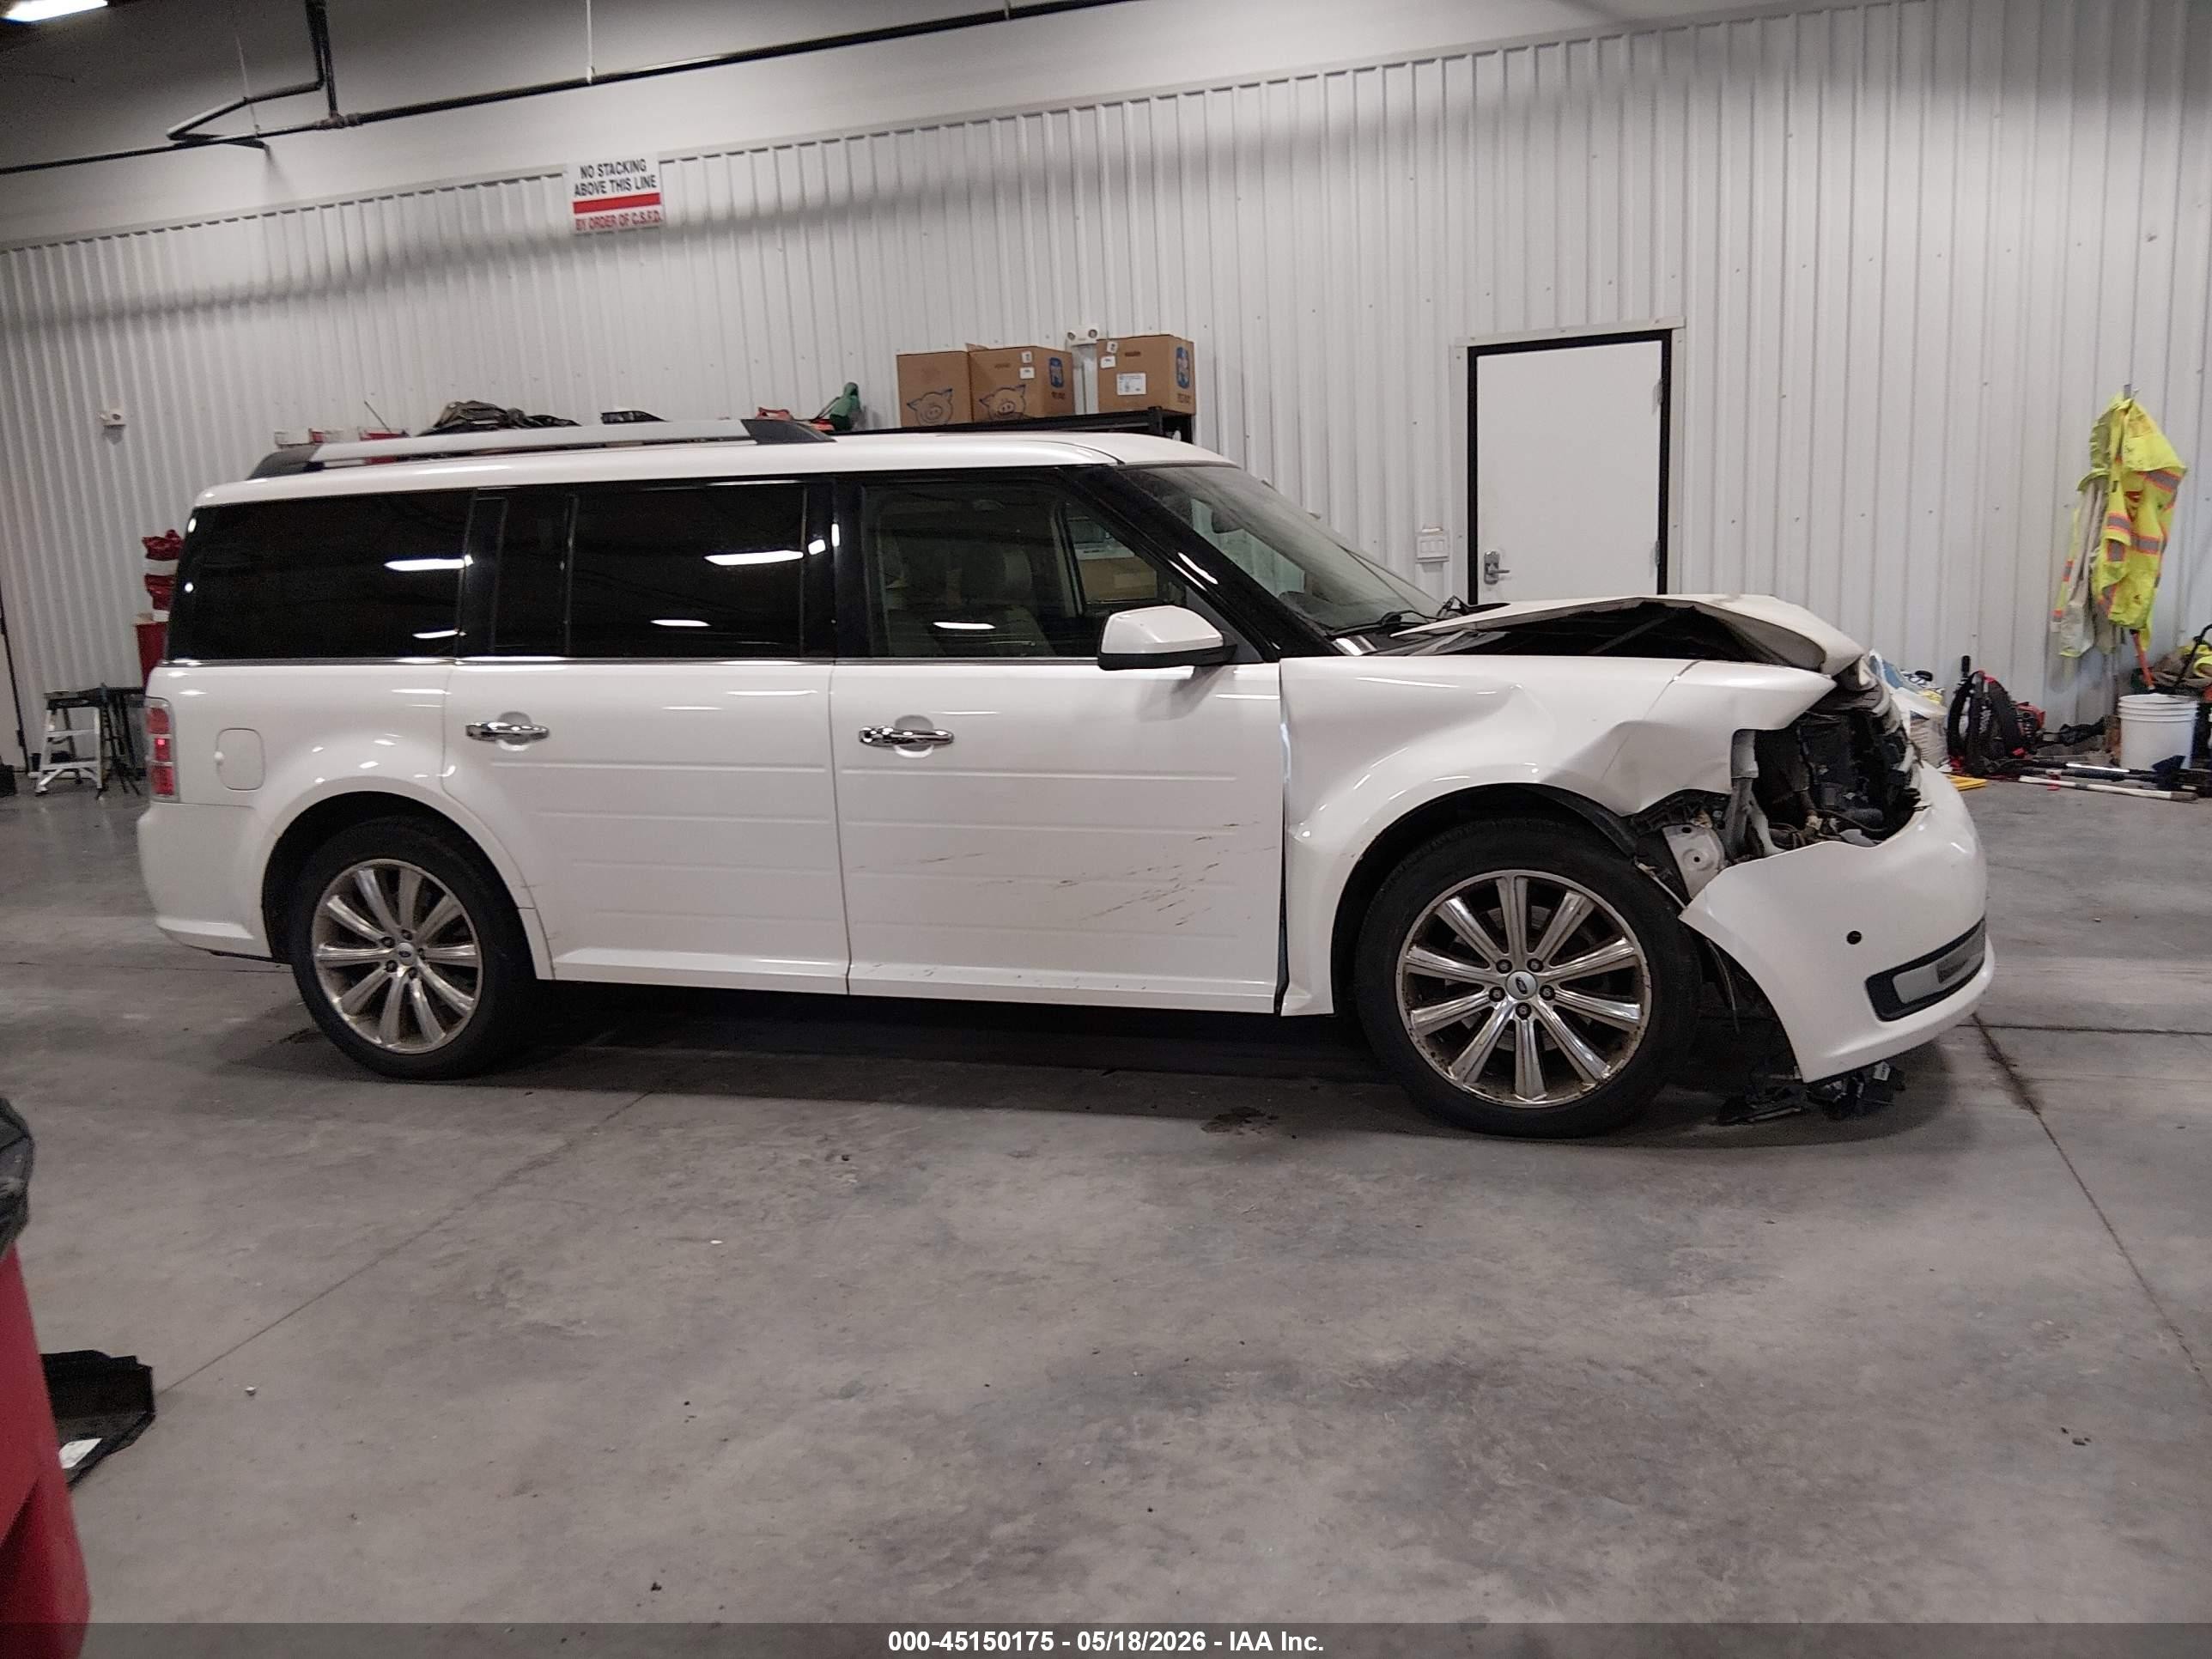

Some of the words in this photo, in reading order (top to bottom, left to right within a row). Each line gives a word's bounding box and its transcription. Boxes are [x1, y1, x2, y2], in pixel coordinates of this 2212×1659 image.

[580, 165, 594, 179] NO
[598, 159, 647, 177] STACKING
[574, 180, 607, 197] ABOVE
[609, 178, 632, 193] THIS
[635, 174, 657, 191] LINE
[588, 214, 617, 230] ORDER
[618, 213, 630, 227] OF
